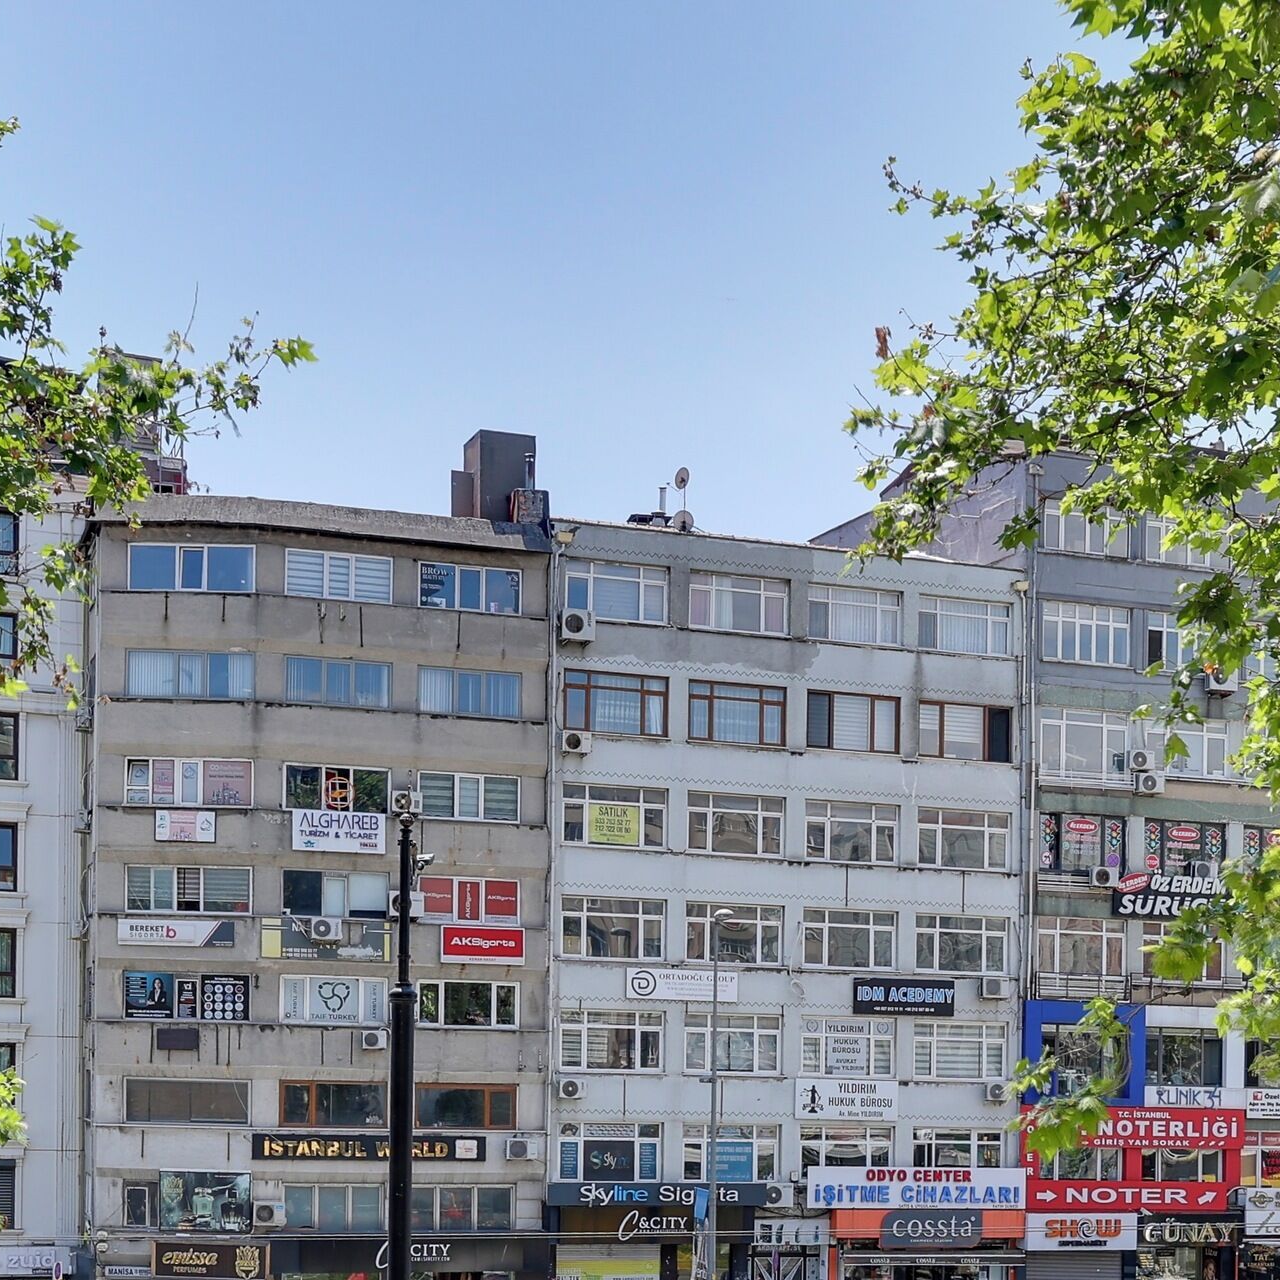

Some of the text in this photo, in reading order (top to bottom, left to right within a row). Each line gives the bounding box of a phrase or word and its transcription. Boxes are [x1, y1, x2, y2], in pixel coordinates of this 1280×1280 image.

[599, 806, 628, 818] SATILIK
[300, 812, 379, 830] ALGHAREB
[299, 829, 329, 838] TURİZM
[344, 830, 378, 840] TİCARET
[1150, 869, 1169, 892] ÖZ
[1170, 876, 1227, 895] ERDEM
[450, 937, 515, 949] AKSigorta
[659, 973, 705, 982] ORTADOĞU
[857, 985, 955, 1004] IDM ACEDEMY
[828, 1025, 864, 1033] YILDIRIM
[832, 1046, 861, 1054] BÜROSU
[838, 1083, 877, 1094] YILDIRIM
[828, 1096, 893, 1108] HUKUK BÜROSU
[1264, 1092, 1280, 1100] Özel
[1133, 1110, 1171, 1118] İSTANBUL
[1098, 1116, 1238, 1138] NOTERLİĞİ
[263, 1137, 449, 1158] İSTANBUL WRLD
[1094, 1138, 1124, 1146] GİRİŞ
[866, 1169, 972, 1182] ODYO CENTER
[580, 1184, 739, 1208] Skyline Sigta
[1066, 1187, 1188, 1204] NOTER
[892, 1215, 972, 1238] cossta
[1045, 1218, 1122, 1239] SHOW
[1143, 1217, 1235, 1244] GÜNAY
[162, 1248, 218, 1266] emissa
[108, 1266, 134, 1275] MANİSA
[173, 1266, 207, 1274] PERFUMES
